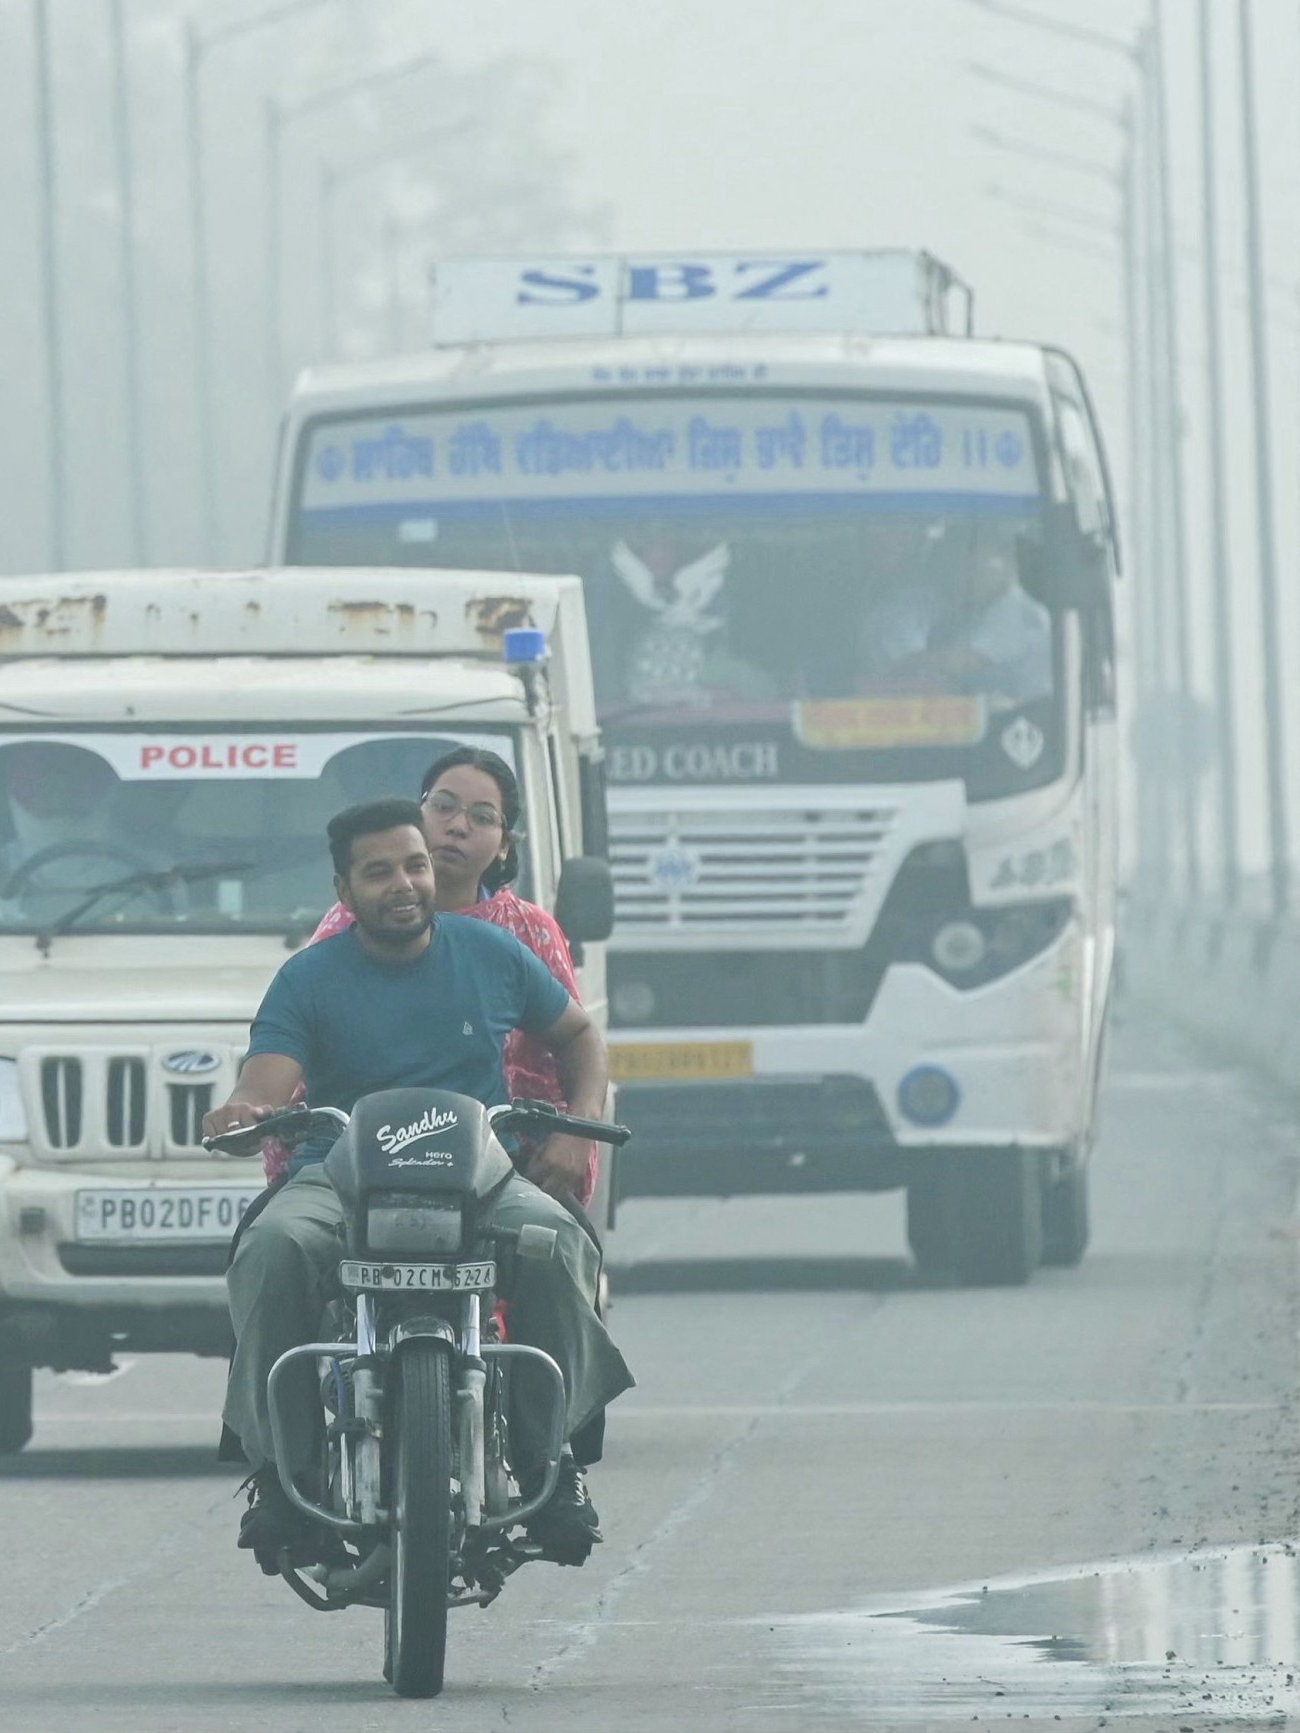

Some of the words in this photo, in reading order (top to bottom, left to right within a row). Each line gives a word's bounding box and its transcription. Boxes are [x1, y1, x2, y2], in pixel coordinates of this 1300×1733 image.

[516, 259, 829, 304] SBZ
[141, 744, 298, 770] POLICE
[663, 741, 778, 779] COACH
[376, 1106, 459, 1154] Sandhu
